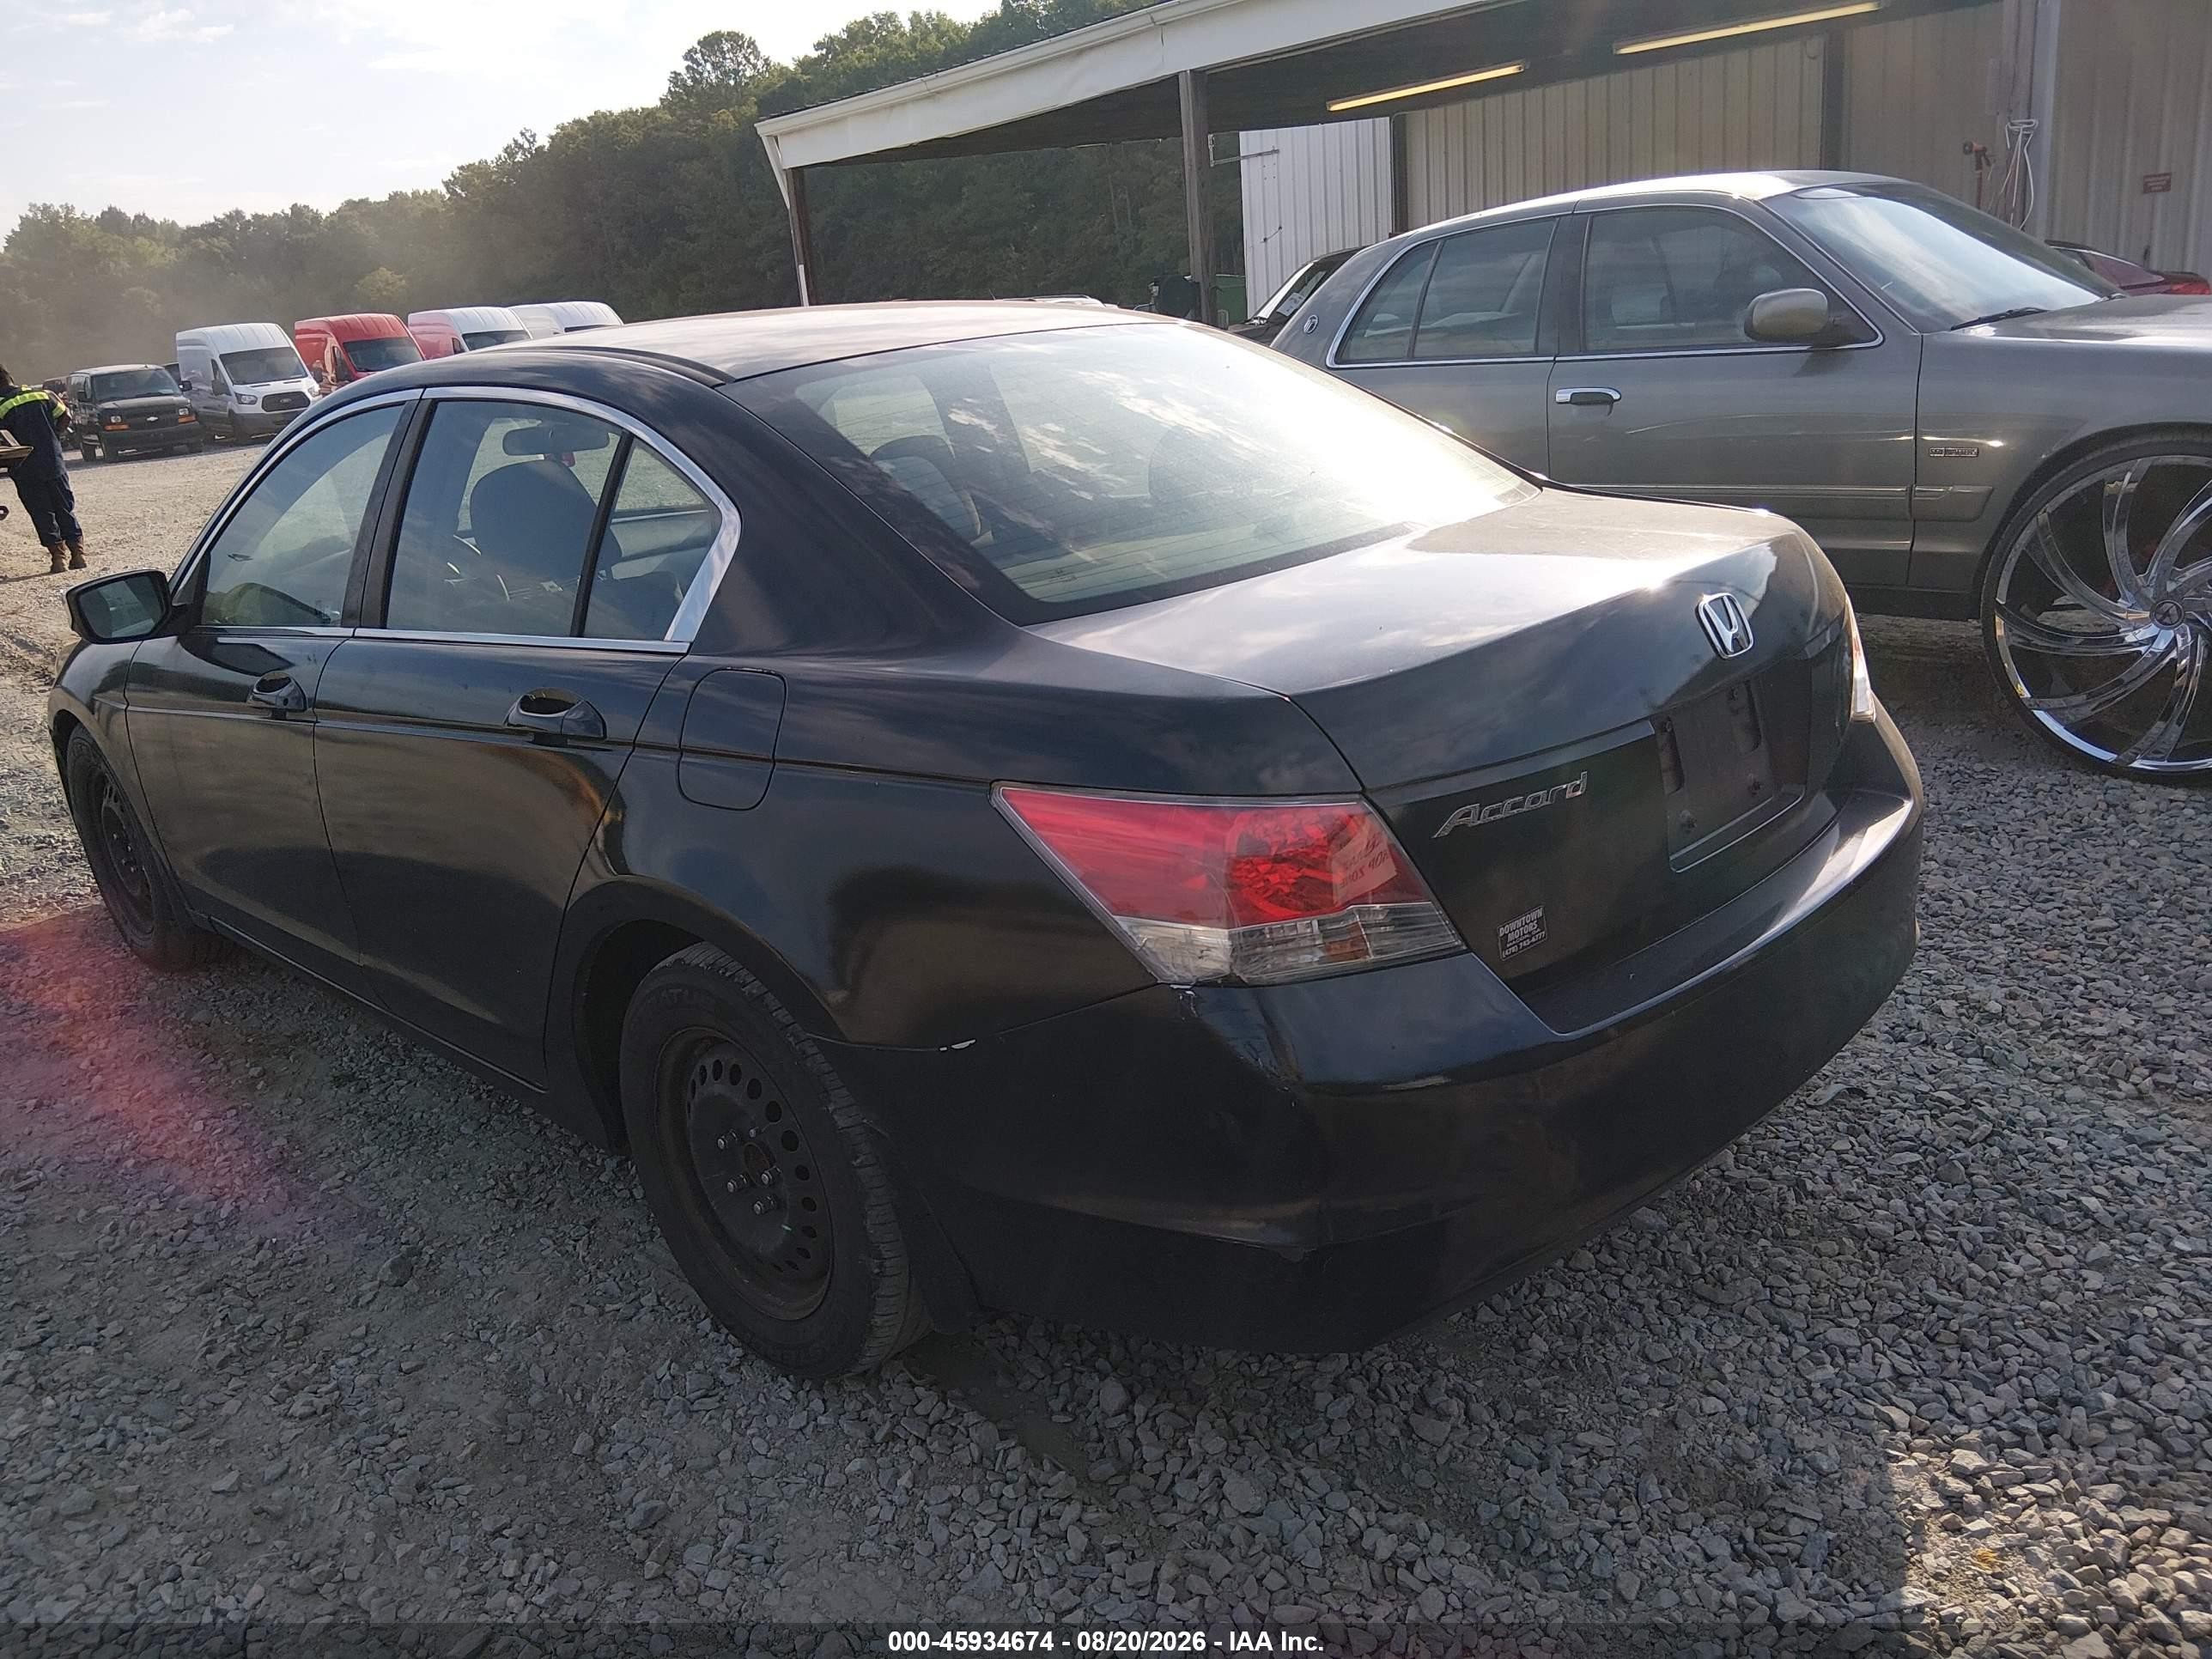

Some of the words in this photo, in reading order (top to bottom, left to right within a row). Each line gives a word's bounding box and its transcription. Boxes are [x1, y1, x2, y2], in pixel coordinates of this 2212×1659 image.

[1431, 771, 1588, 839] Accord
[1498, 907, 1544, 937] DOWNTOWN
[1507, 920, 1539, 943] MOTORS
